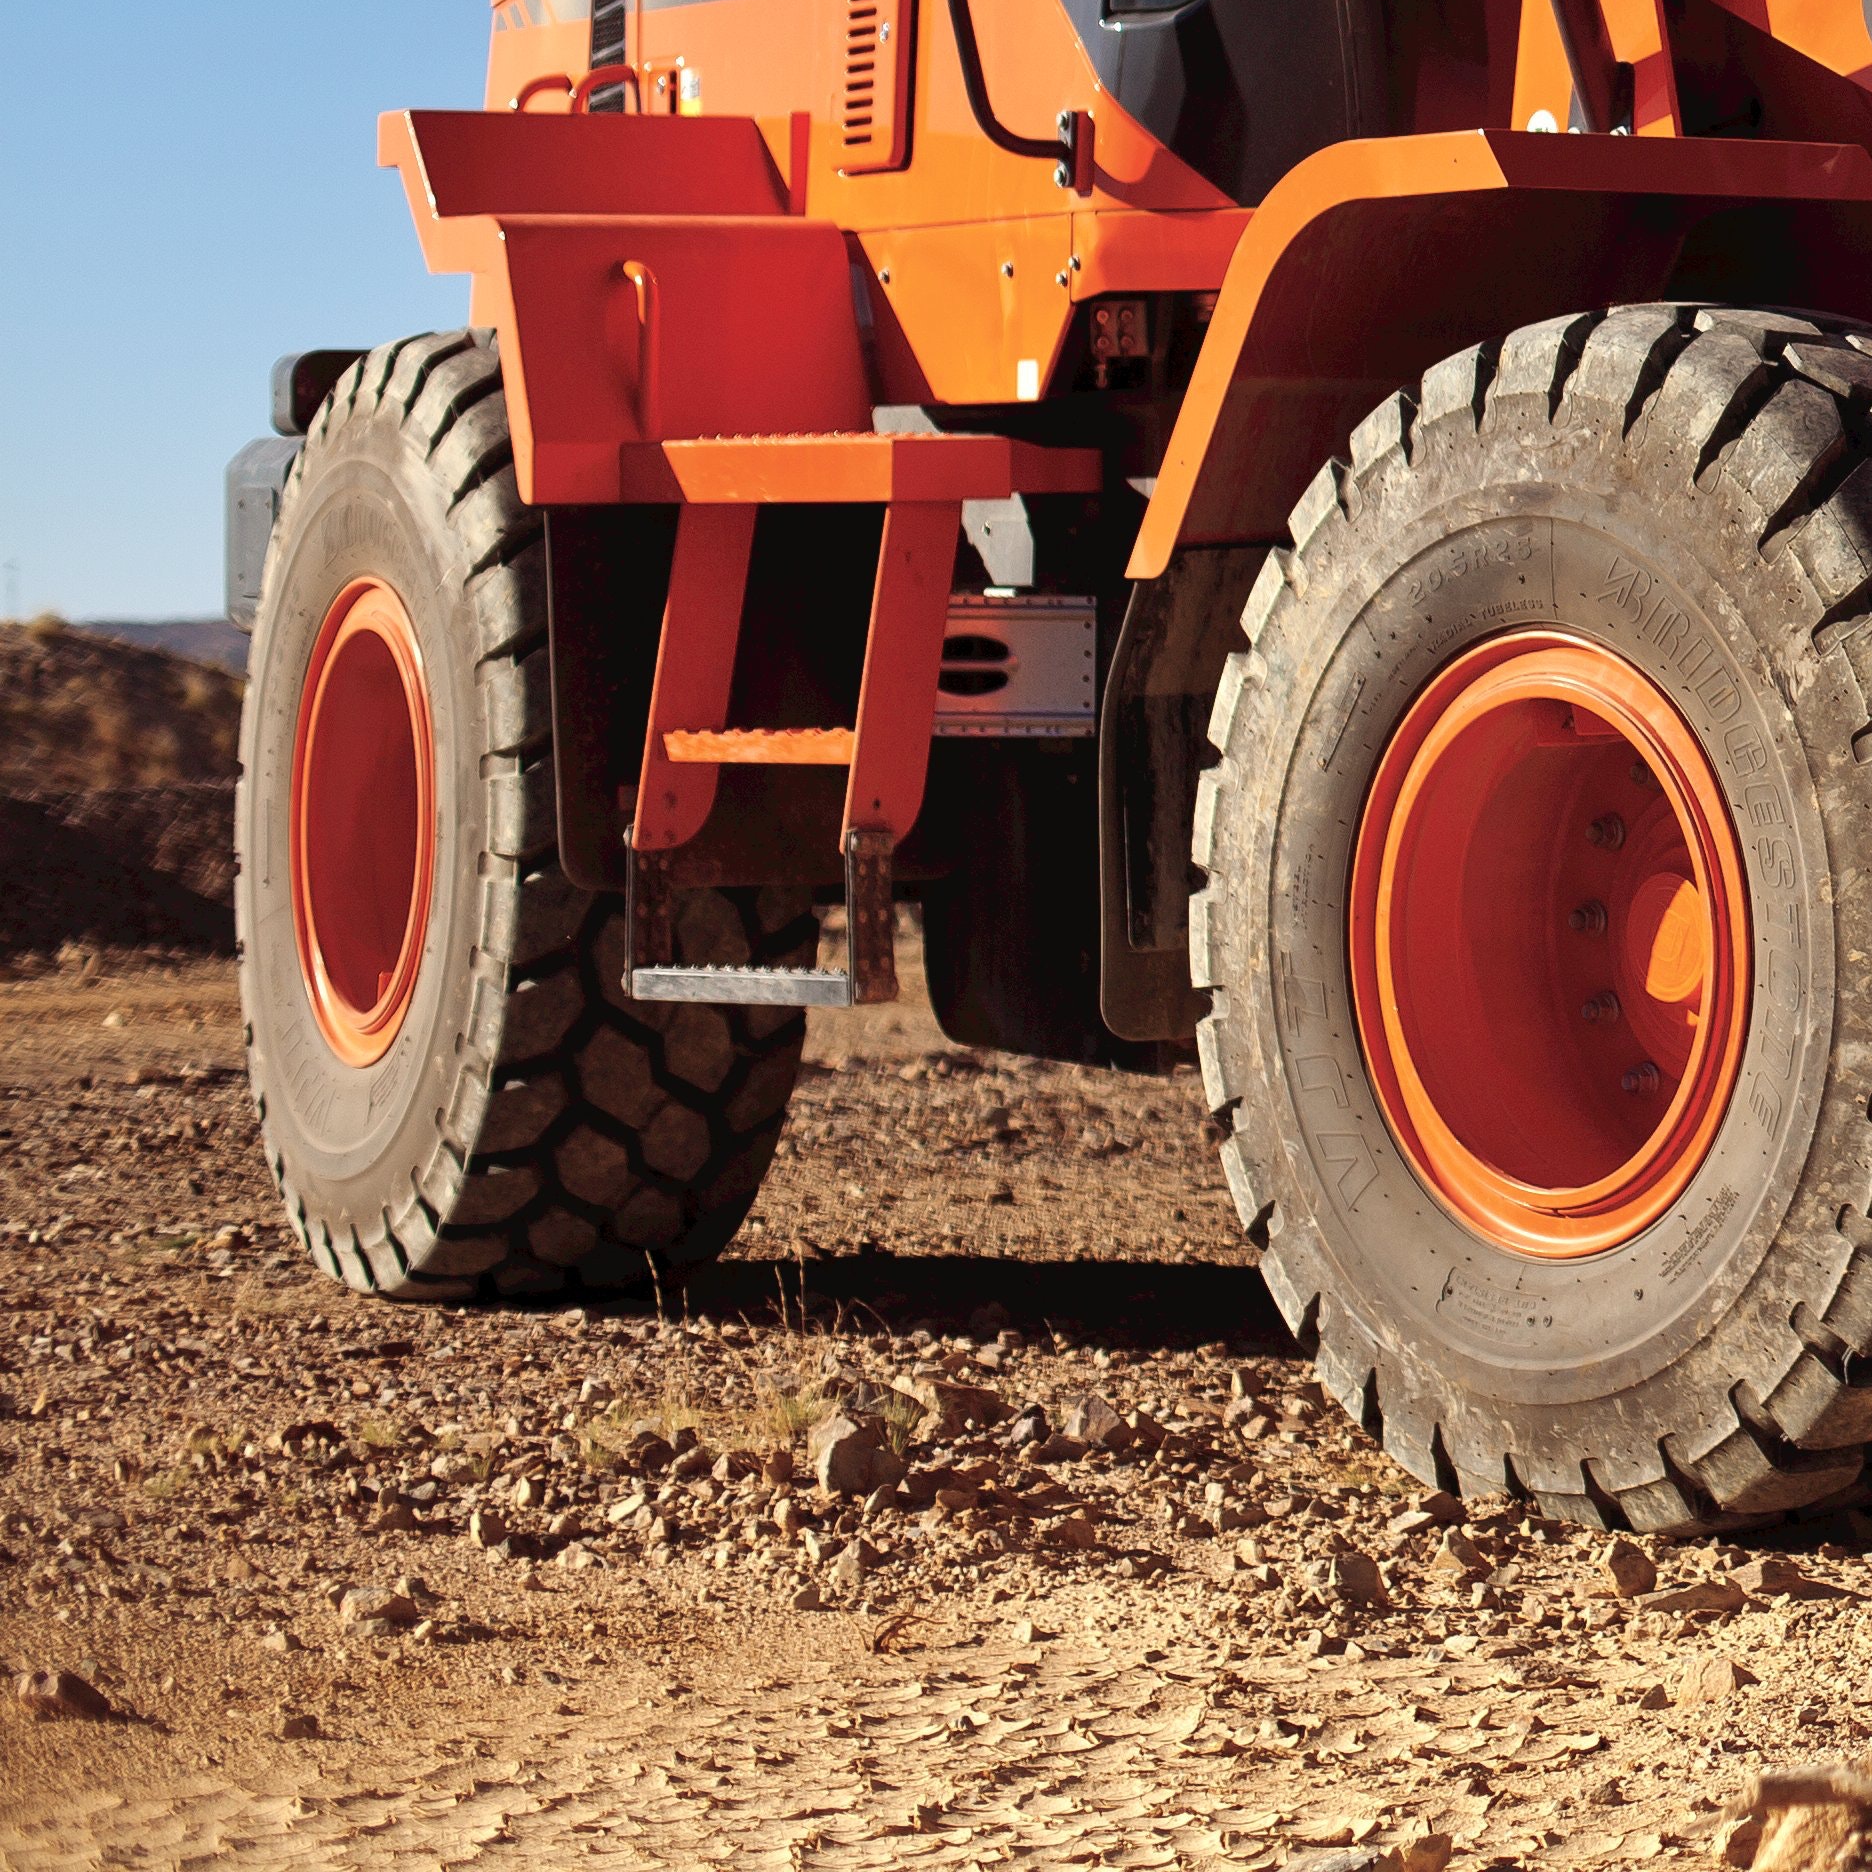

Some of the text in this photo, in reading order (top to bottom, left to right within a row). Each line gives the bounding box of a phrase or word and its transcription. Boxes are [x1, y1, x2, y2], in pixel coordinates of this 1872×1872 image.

[1406, 537, 1535, 608] 20.5R25
[1597, 555, 1801, 1143] BRIDGESTONE
[1280, 950, 1380, 1212] VJT
